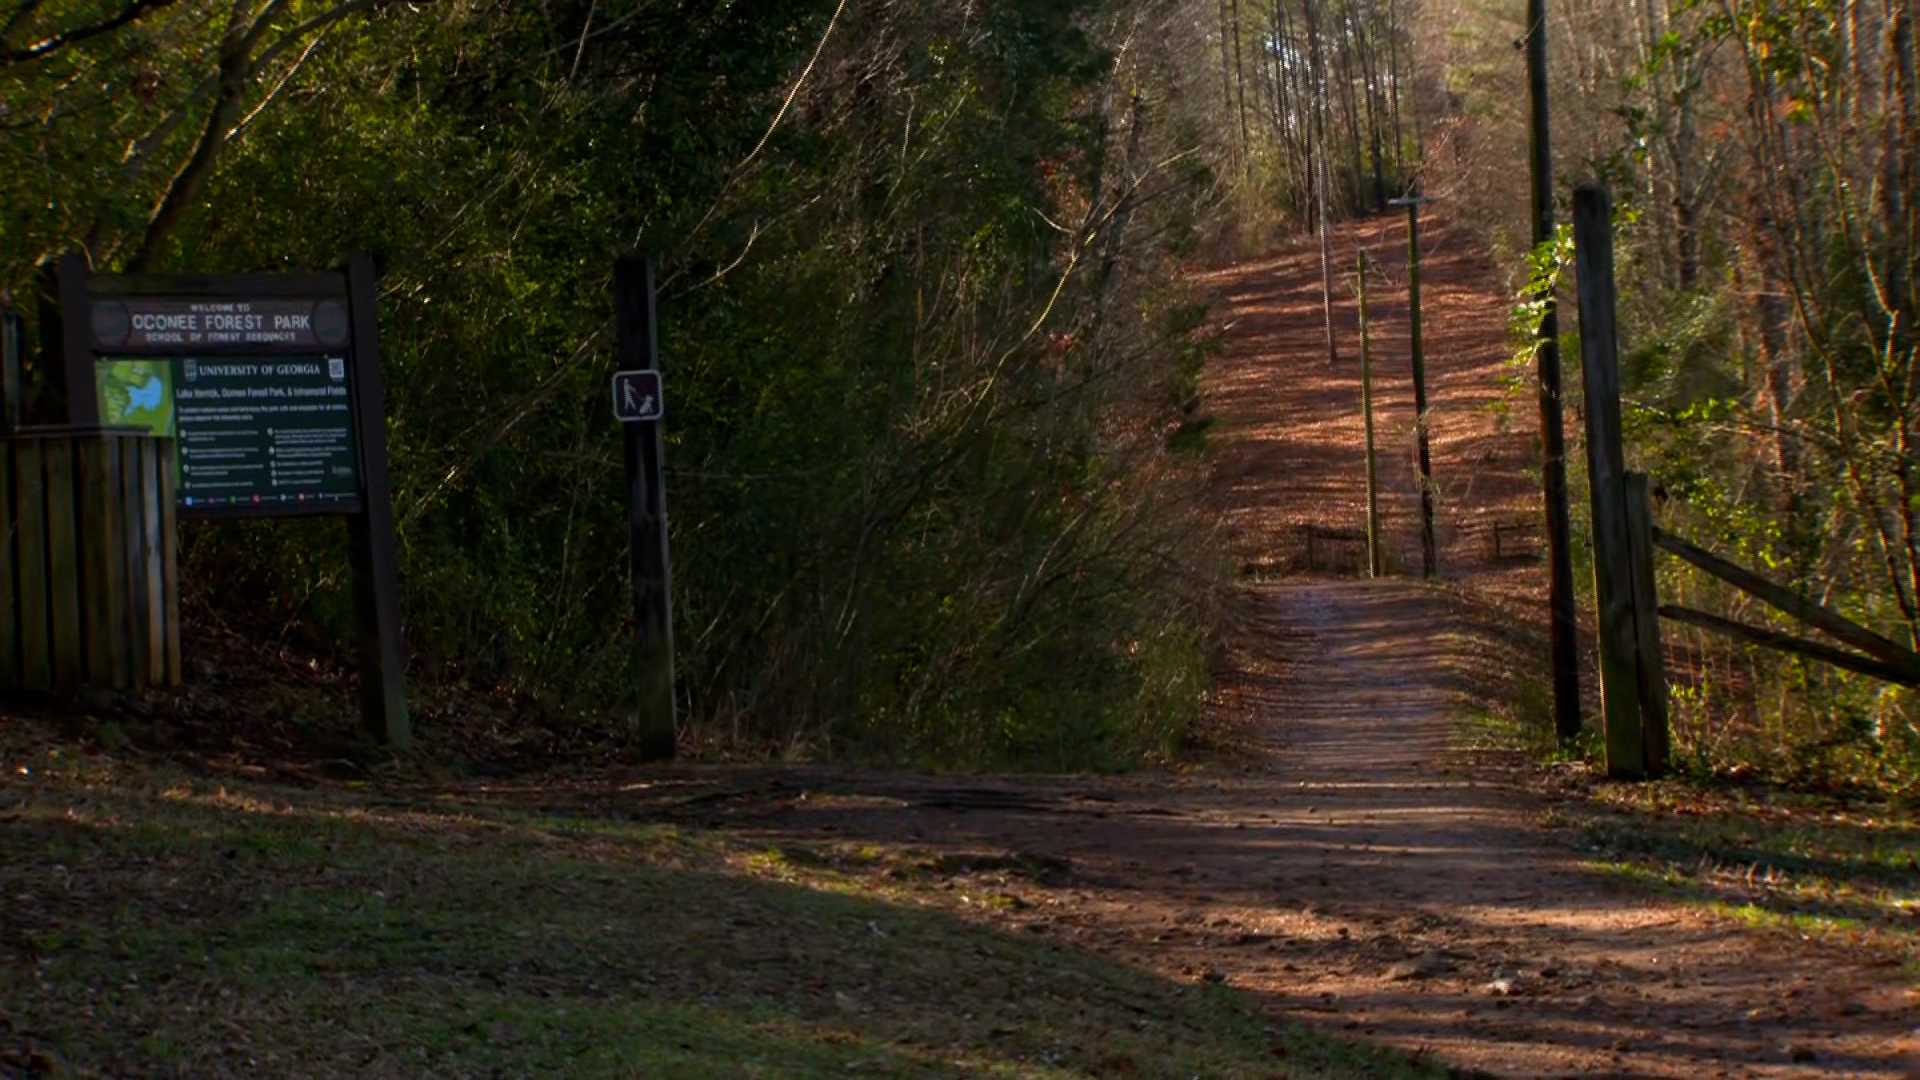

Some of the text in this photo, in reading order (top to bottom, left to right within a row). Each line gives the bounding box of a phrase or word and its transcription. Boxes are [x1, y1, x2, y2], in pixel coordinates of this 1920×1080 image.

[132, 314, 311, 330] OCONEE FOREST PARK
[199, 363, 321, 377] UNIVERSITY OF GEORGIA
